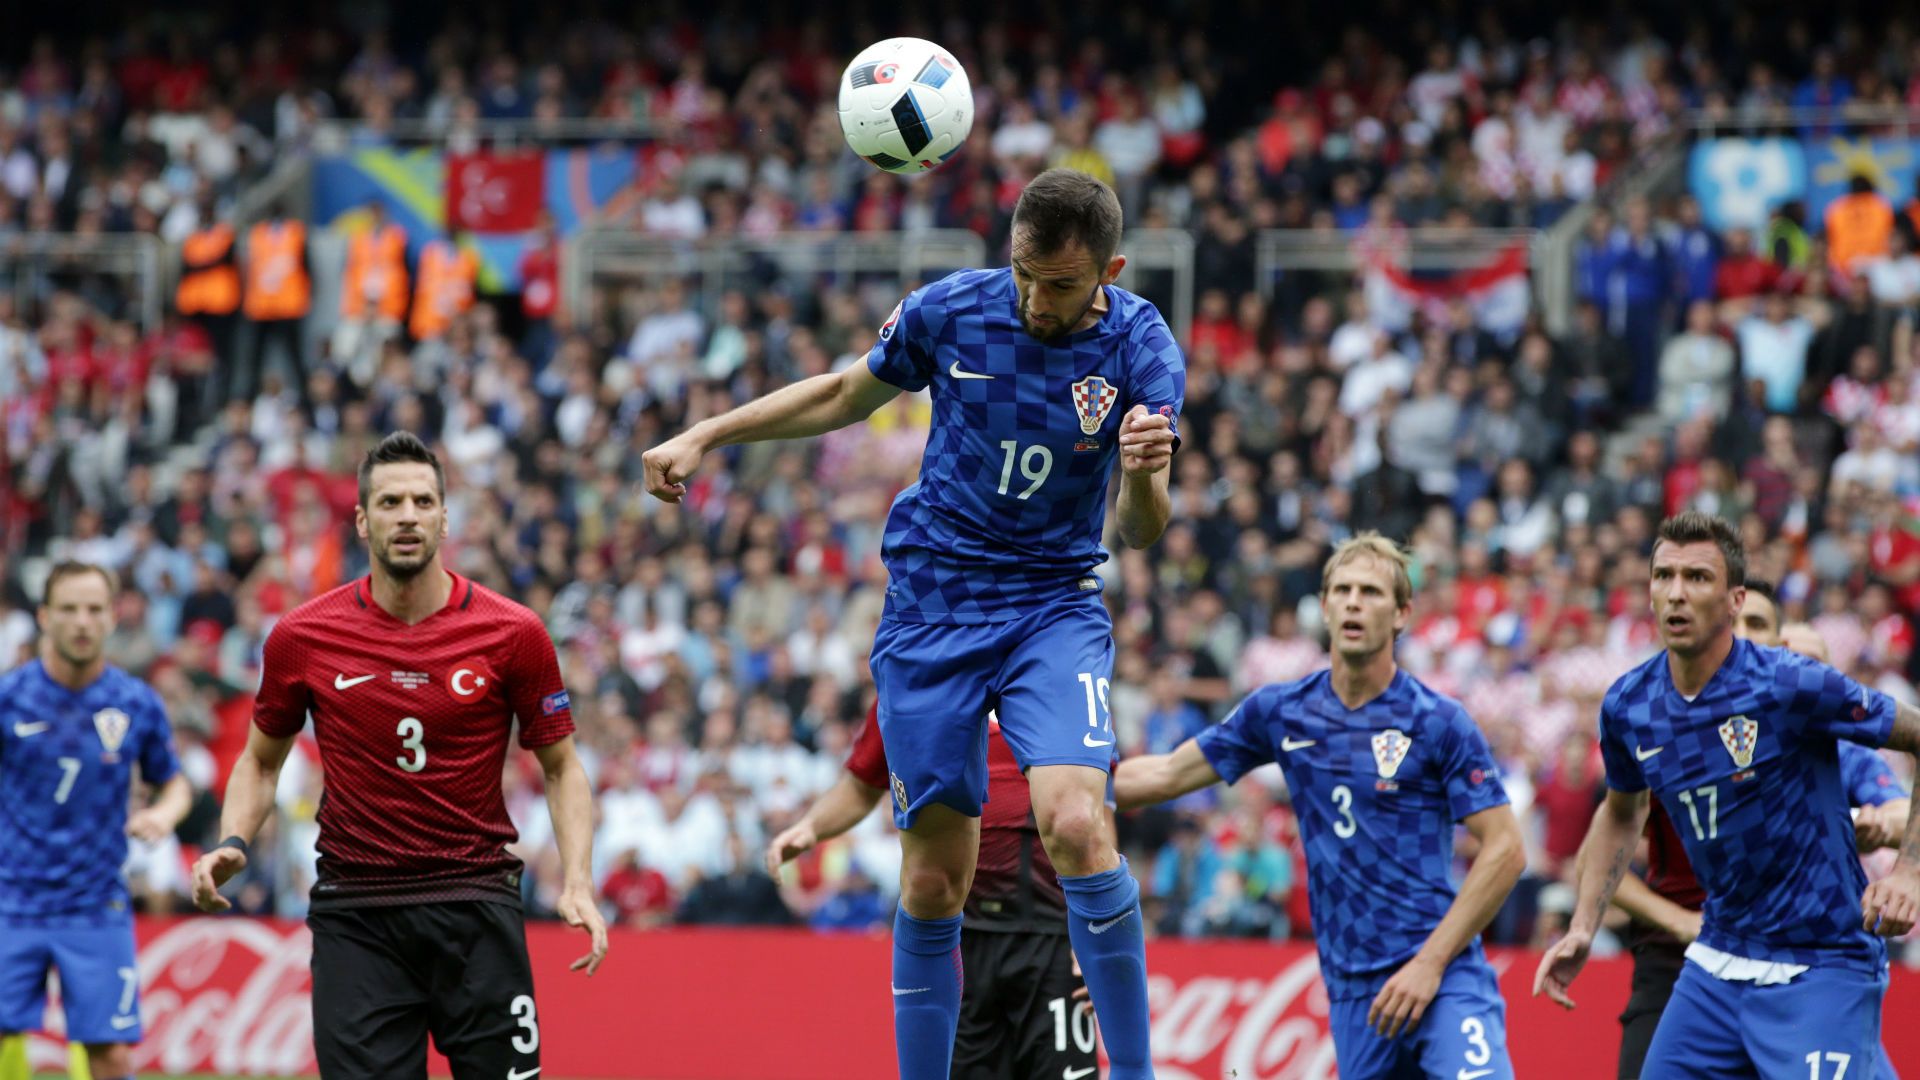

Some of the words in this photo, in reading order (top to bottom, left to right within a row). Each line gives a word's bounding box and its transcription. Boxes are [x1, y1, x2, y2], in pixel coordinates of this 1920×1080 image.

[997, 440, 1054, 500] 19
[1078, 672, 1110, 734] 19
[396, 717, 428, 773] 3
[54, 757, 82, 804] 7
[1331, 785, 1357, 839] 3
[1678, 785, 1718, 841] 17
[117, 966, 139, 1015] 7
[510, 995, 540, 1054] 3
[1048, 996, 1096, 1054] 10
[1461, 1016, 1491, 1066] 3
[1805, 1050, 1852, 1080] 17
